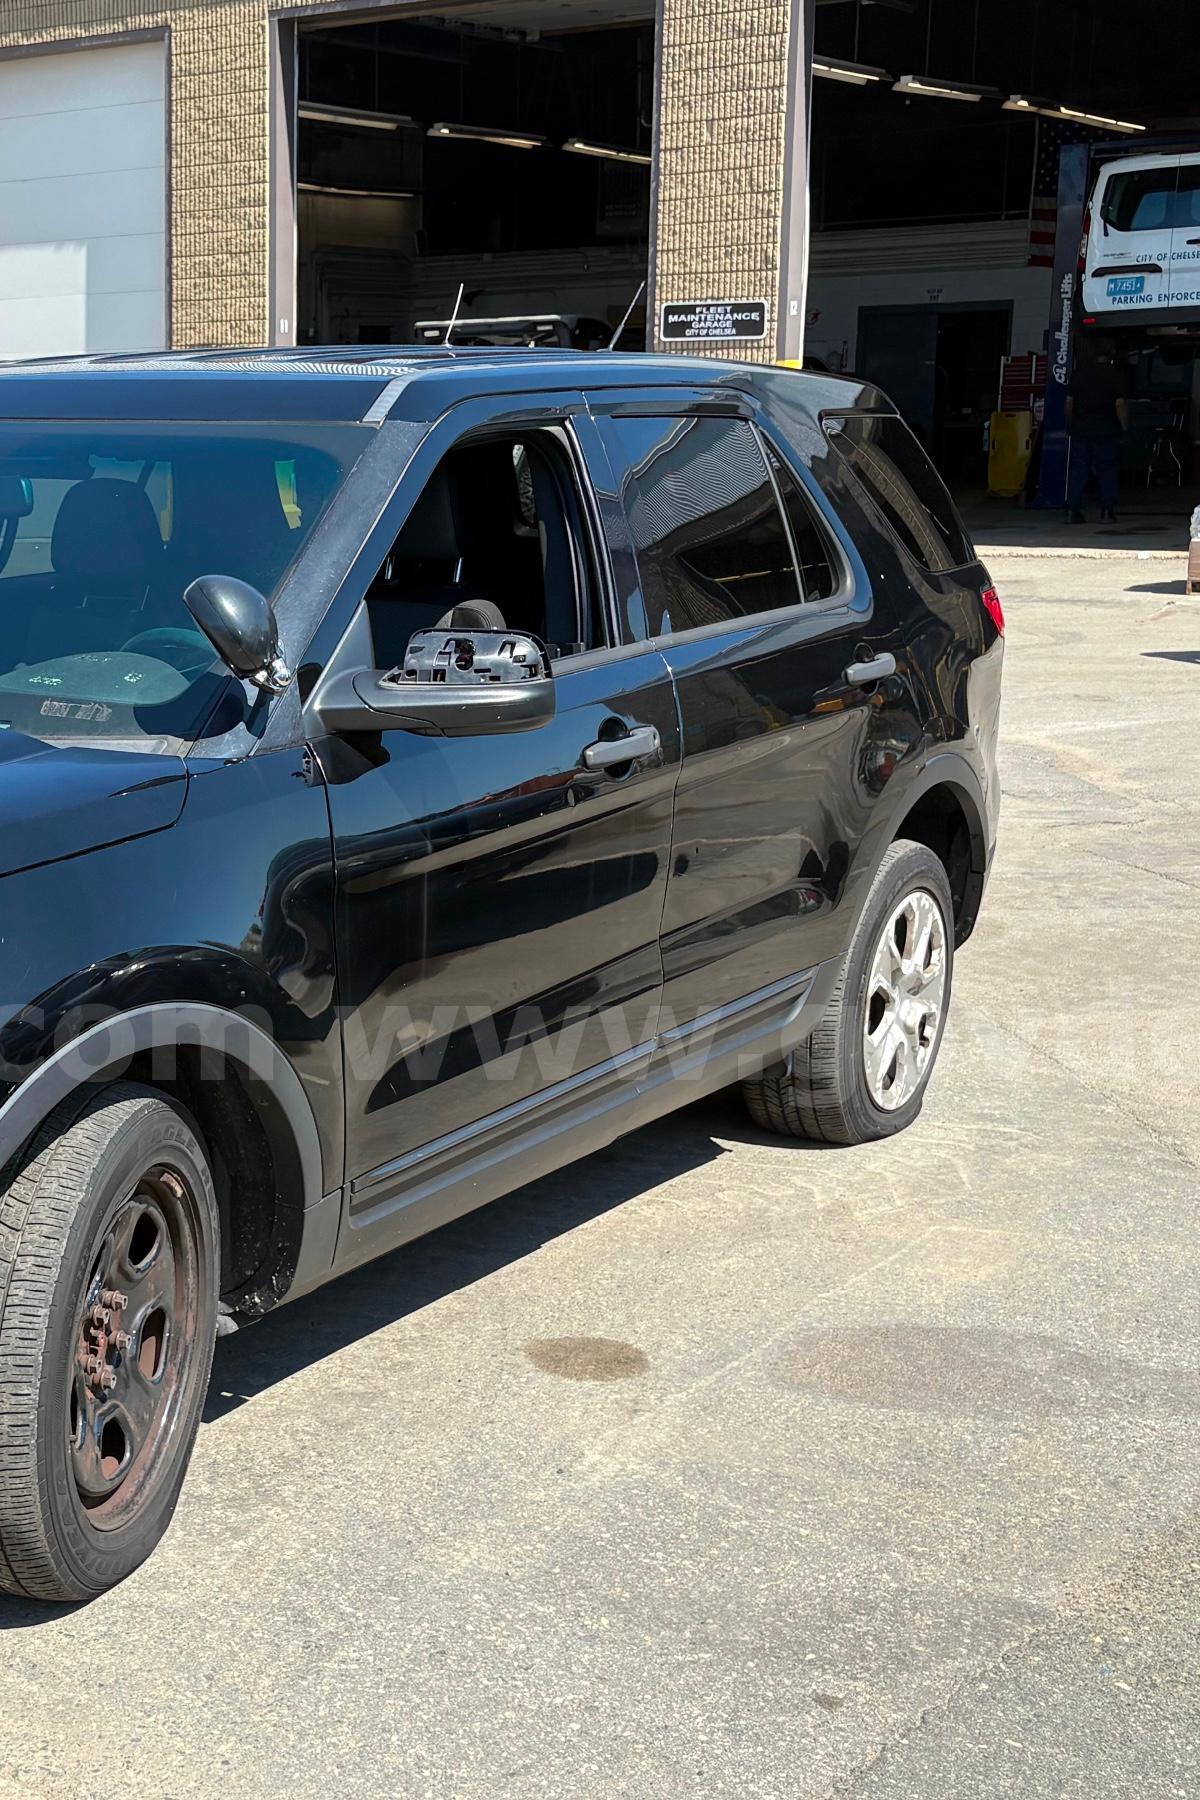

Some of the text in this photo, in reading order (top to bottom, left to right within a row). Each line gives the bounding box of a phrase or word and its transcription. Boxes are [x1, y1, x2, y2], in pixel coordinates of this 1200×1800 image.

[1136, 254, 1153, 263] CITY
[1156, 253, 1168, 262] OF
[1060, 273, 1073, 299] Lifts
[1111, 291, 1200, 305] PARKING ENFORCE
[695, 306, 732, 314] FLEET
[668, 312, 760, 323] MAINTENANCE
[691, 321, 732, 329] GARAGE
[708, 328, 737, 336] CHELSEA
[1054, 299, 1073, 364] Challenger
